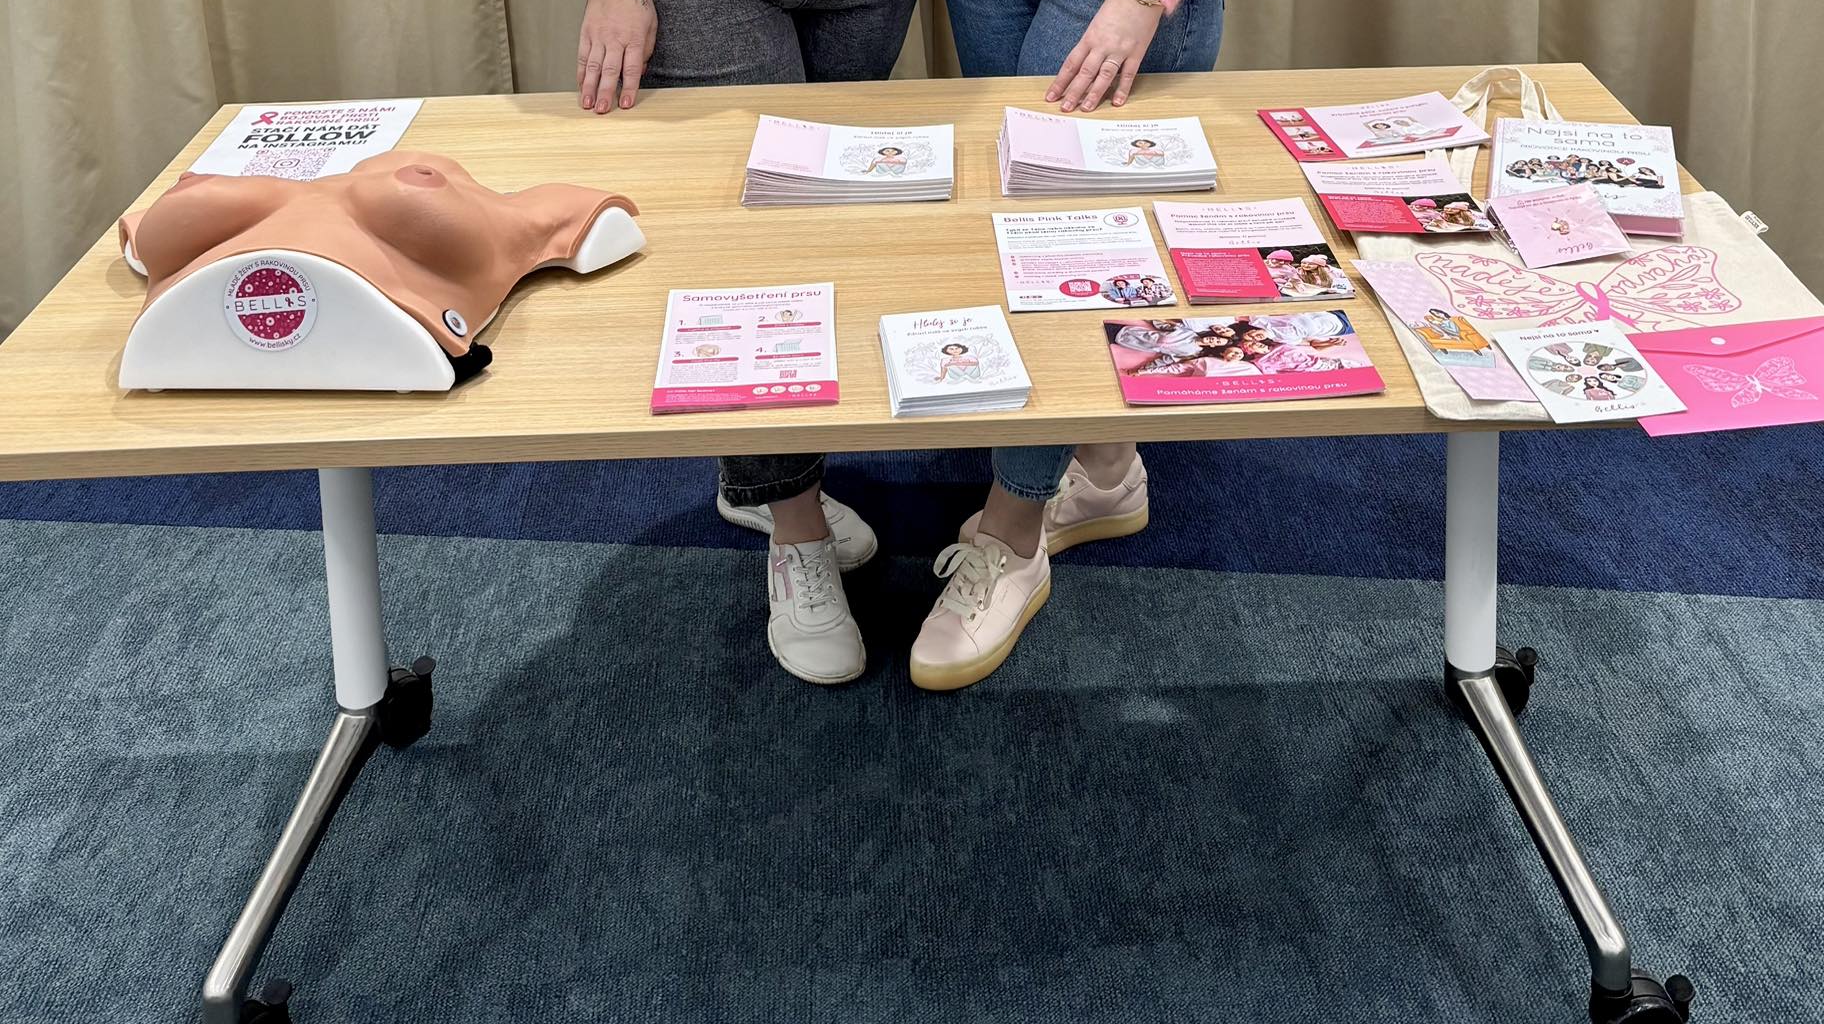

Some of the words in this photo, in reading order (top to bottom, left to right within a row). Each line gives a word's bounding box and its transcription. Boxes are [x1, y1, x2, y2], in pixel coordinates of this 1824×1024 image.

[284, 108, 344, 116] POMOZTE
[251, 125, 300, 134] STAČÍ
[304, 124, 343, 132] NÁM
[347, 123, 381, 131] DÁT
[1527, 127, 1578, 137] Nejsi
[1588, 131, 1614, 140] na
[1623, 132, 1643, 141] to
[243, 130, 376, 144] FOLLOW
[1553, 138, 1616, 147] sama
[263, 139, 367, 149] INSTAGRAMU!
[1067, 213, 1098, 221] Talks
[227, 275, 240, 297] MLADÉ
[238, 262, 254, 276] ŽENY
[260, 260, 299, 276] RAKOVINOU
[298, 274, 311, 291] PRSU
[1421, 254, 1575, 296] naděje
[683, 291, 787, 302] Samovyšetření
[791, 290, 821, 299] prsu
[1520, 334, 1542, 342] Nejsi
[1156, 387, 1218, 396] Pomáháme
[1221, 387, 1257, 396] ženám
[1268, 384, 1321, 393] rakovinou
[1323, 382, 1348, 390] prsu
[1594, 403, 1637, 414] Bellis
